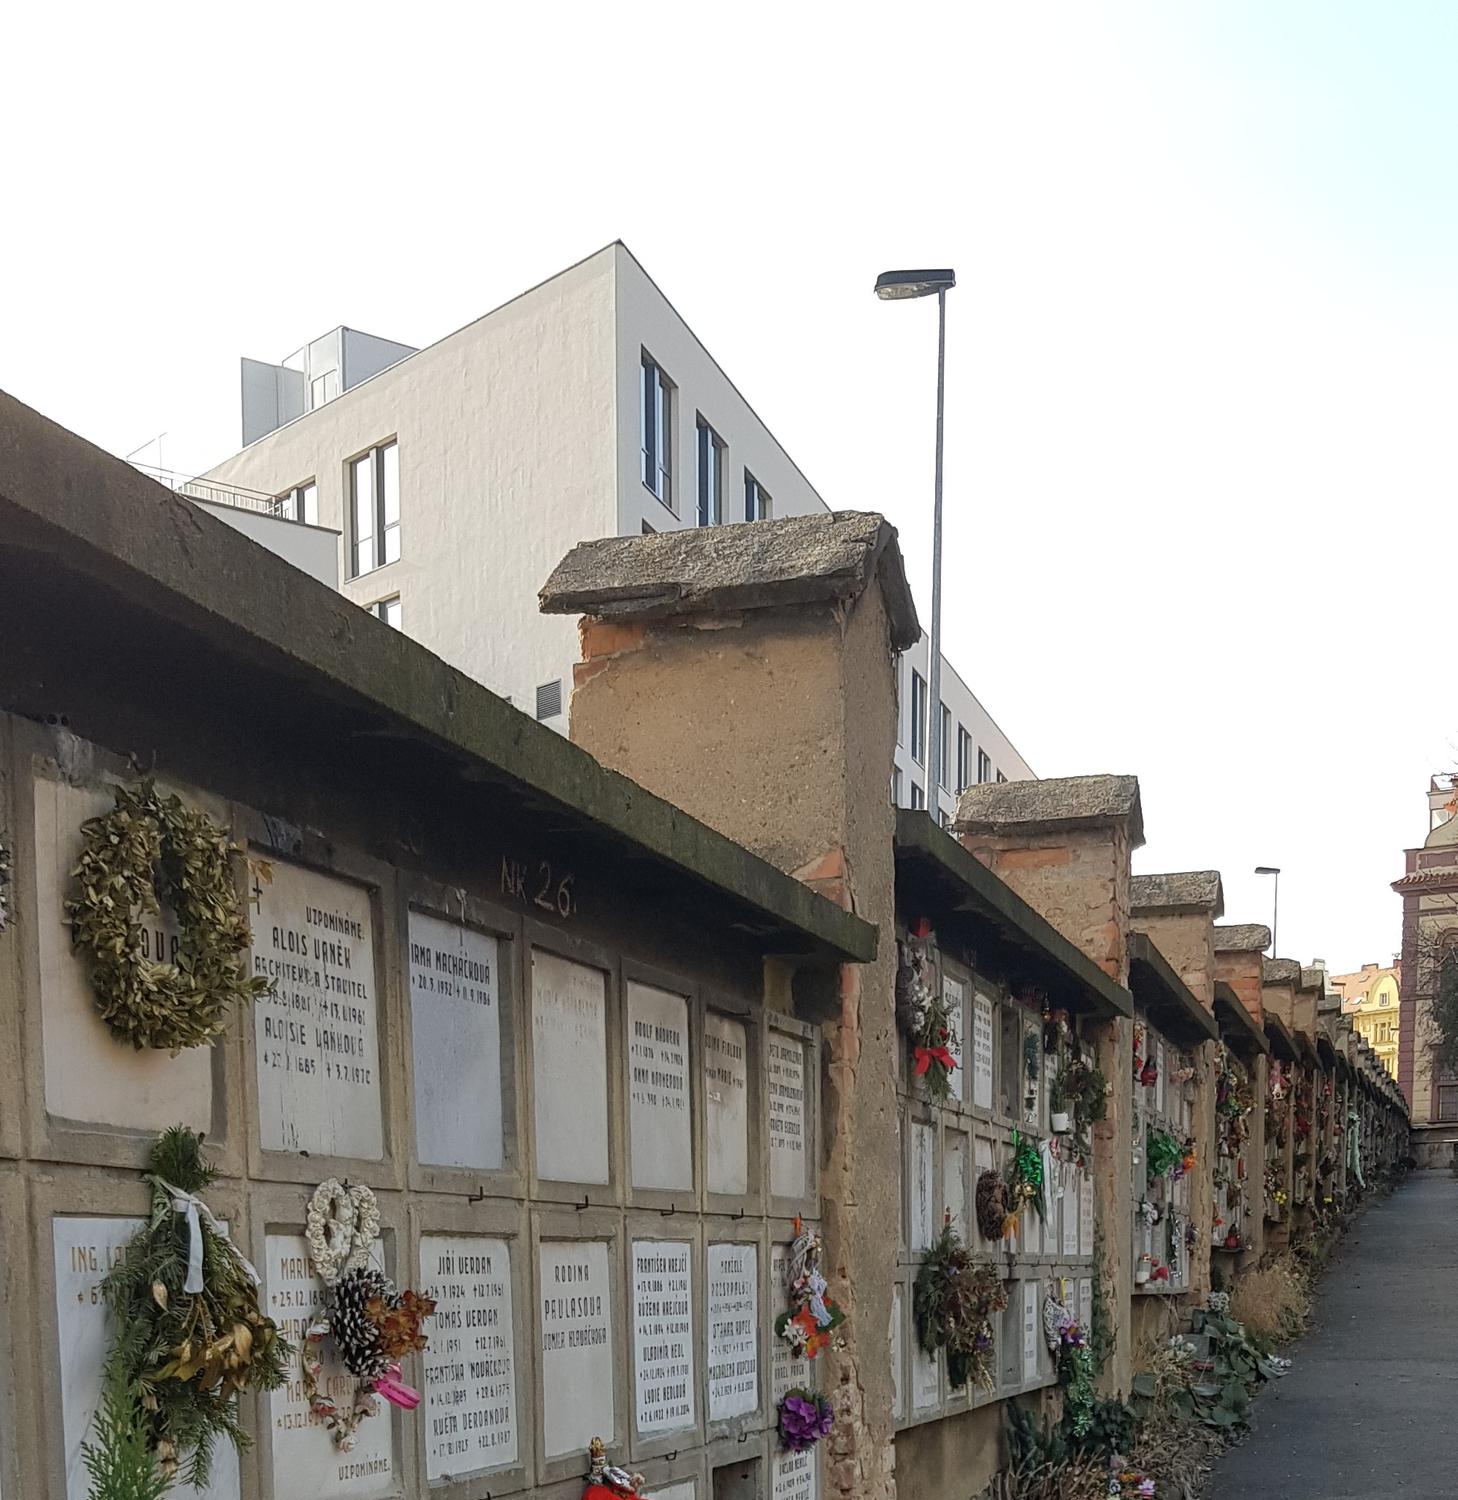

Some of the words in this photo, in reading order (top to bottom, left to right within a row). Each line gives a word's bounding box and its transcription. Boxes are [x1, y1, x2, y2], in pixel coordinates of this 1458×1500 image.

[272, 926, 308, 956] ALOIS
[411, 943, 432, 968] IRMA
[71, 1246, 103, 1272] ING.
[280, 1257, 314, 1280] MARIE
